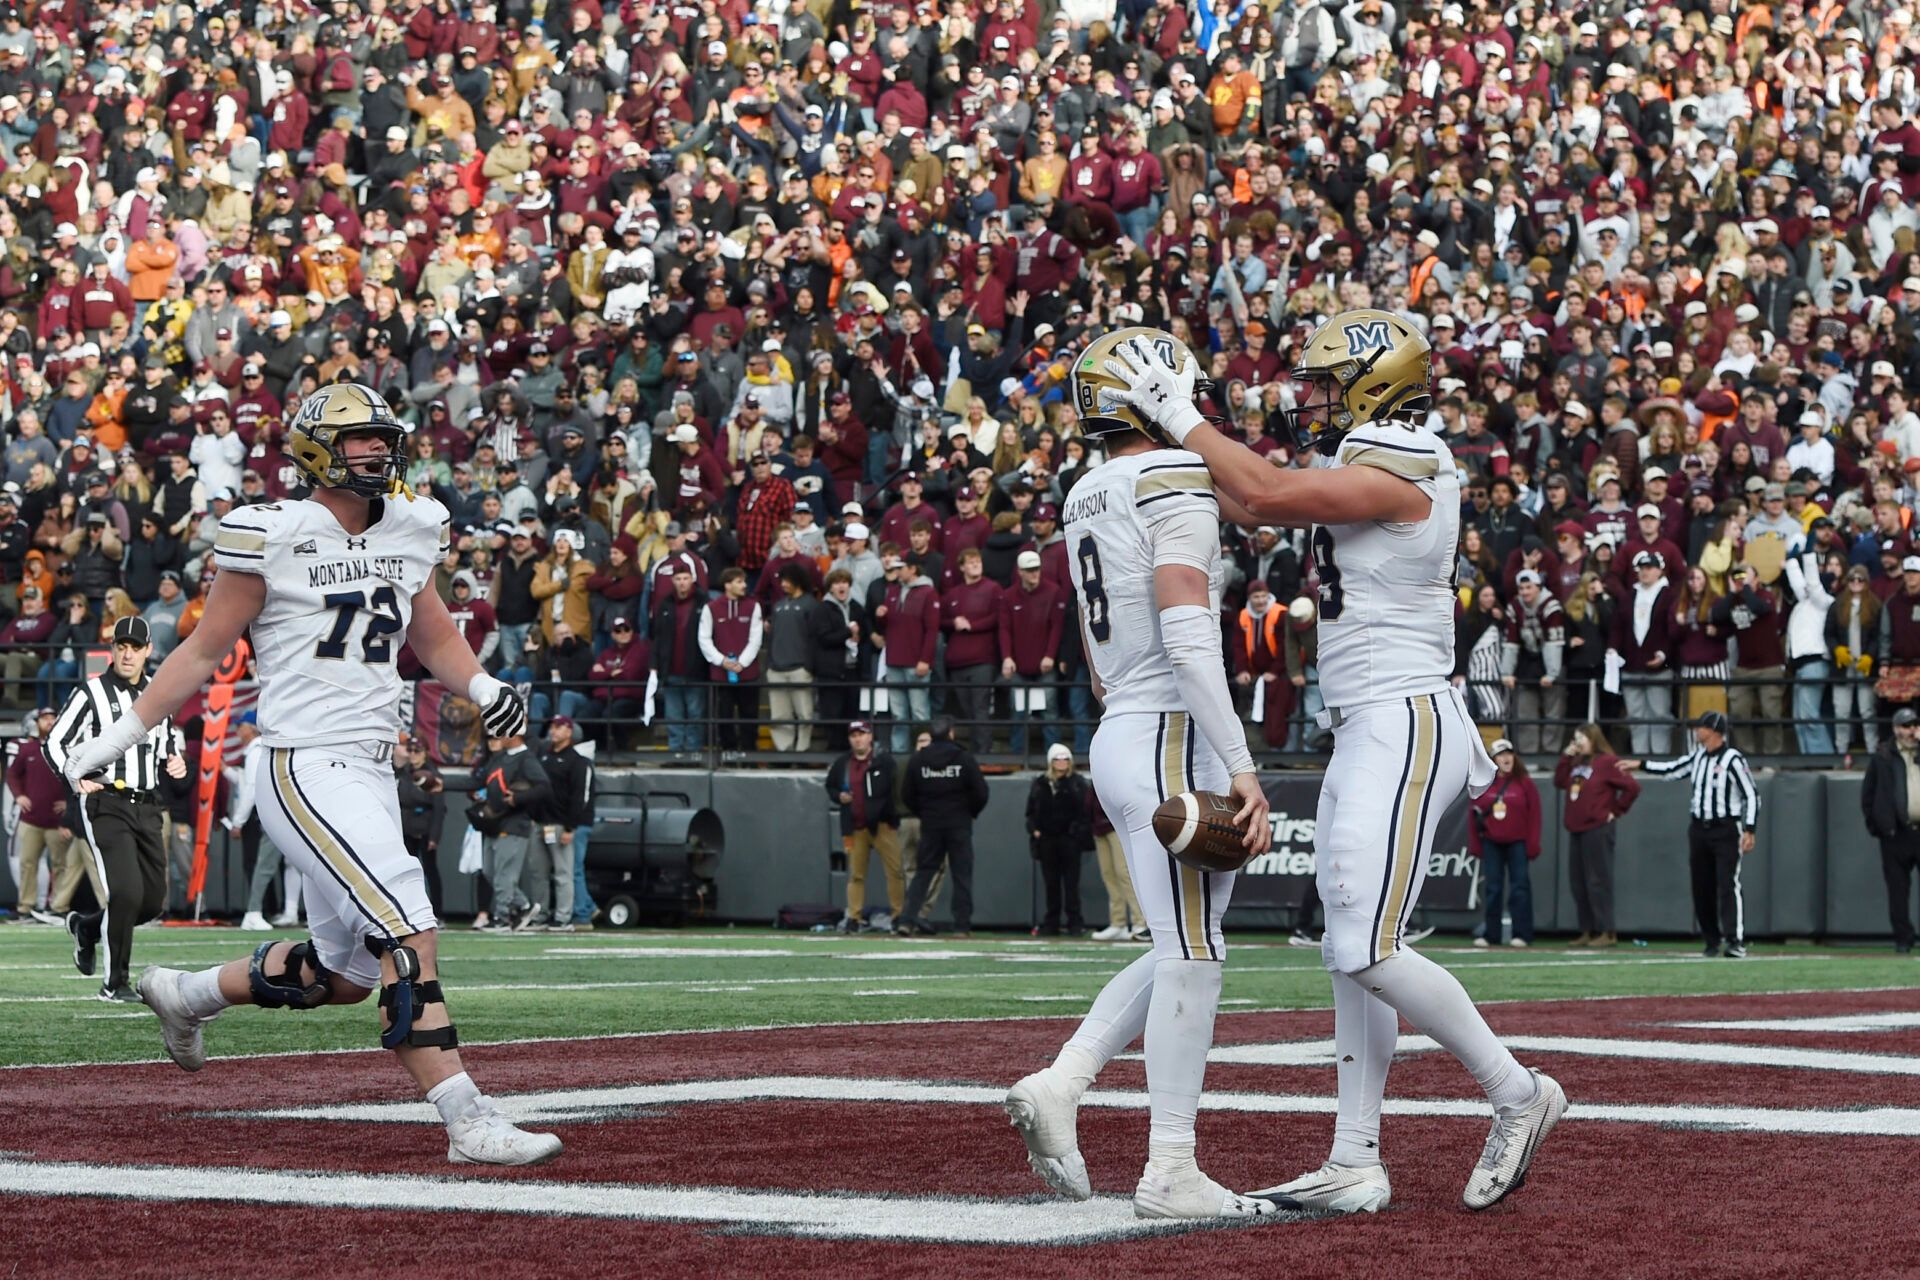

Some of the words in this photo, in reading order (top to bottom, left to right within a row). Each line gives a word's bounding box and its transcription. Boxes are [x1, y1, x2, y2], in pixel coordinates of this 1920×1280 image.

[1342, 320, 1395, 356] M
[299, 394, 333, 424] M
[1082, 385, 1093, 408] 8
[1062, 490, 1108, 526] LAMSON
[308, 558, 370, 588] MONTANA
[374, 558, 404, 581] STATE
[1077, 531, 1111, 645] 8
[313, 586, 404, 665] 72
[111, 702, 120, 712] S
[1267, 812, 1316, 842] irs
[1246, 846, 1316, 875] Inter
[1425, 846, 1475, 876] ank
